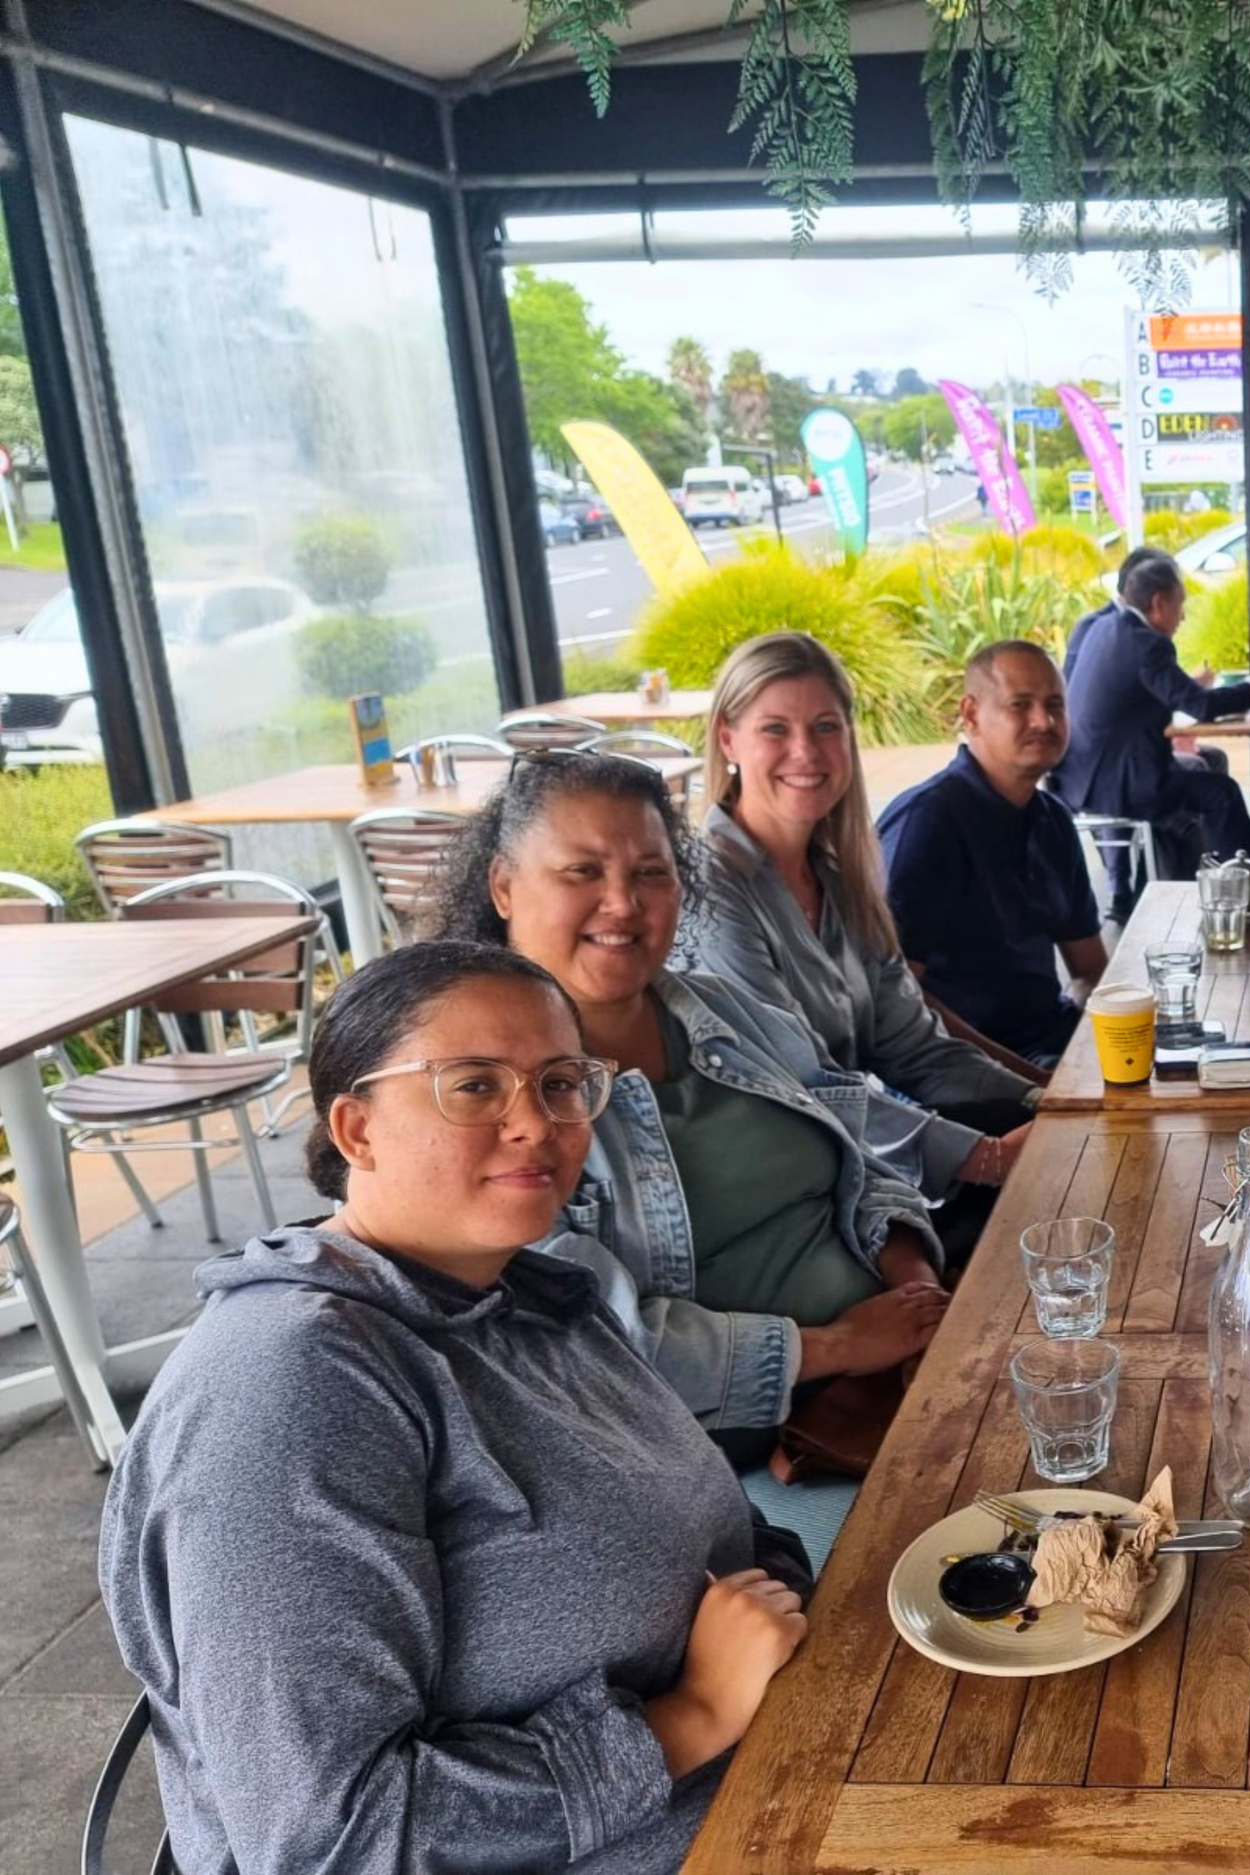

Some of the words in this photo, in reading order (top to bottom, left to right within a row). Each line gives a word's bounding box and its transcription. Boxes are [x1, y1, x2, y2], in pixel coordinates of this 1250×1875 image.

[1139, 353, 1150, 376] B
[1141, 385, 1151, 408] C
[1142, 418, 1154, 439] D
[1145, 449, 1153, 471] E
